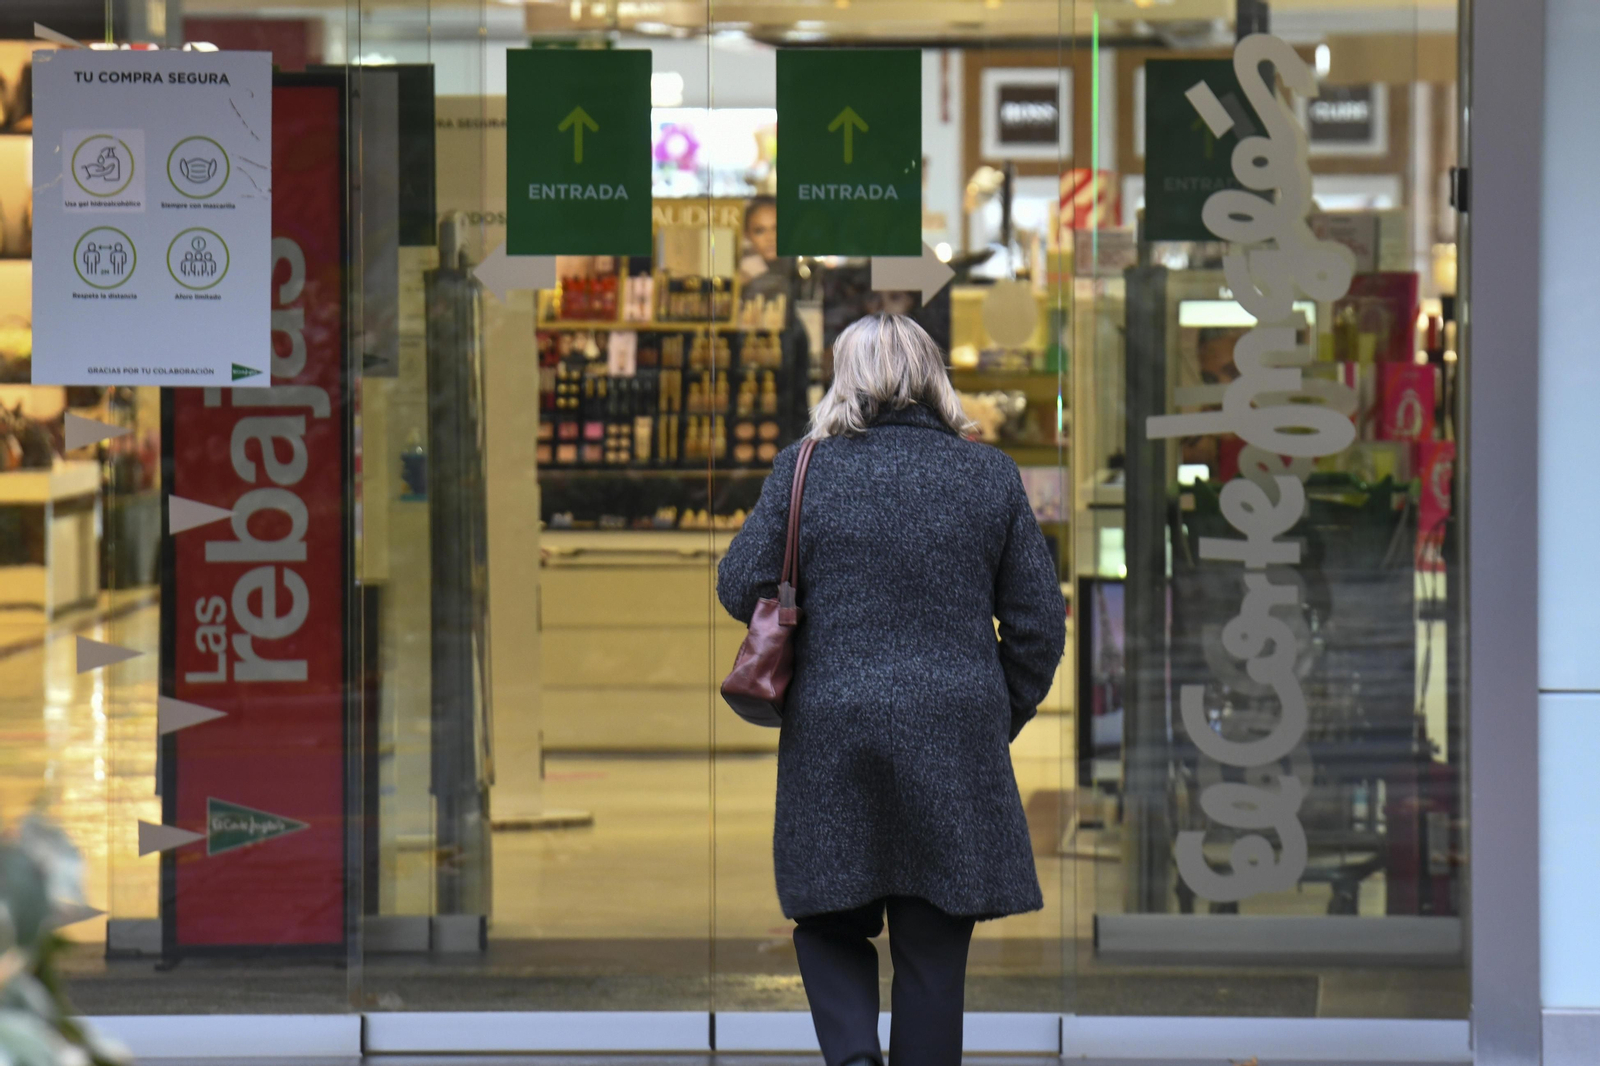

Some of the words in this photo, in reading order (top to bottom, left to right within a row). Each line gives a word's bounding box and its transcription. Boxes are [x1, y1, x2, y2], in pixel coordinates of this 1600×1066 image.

[73, 71, 94, 83] TU
[98, 71, 164, 84] COMPRA
[168, 72, 231, 85] SEGURA
[1163, 176, 1239, 191] ENTRAD
[528, 183, 629, 200] ENTRADA
[798, 183, 898, 200] ENTRADA
[78, 200, 89, 209] gel
[161, 201, 188, 210] Siempre
[202, 202, 236, 210] mascarilla
[1145, 33, 1357, 458] Inglés
[72, 291, 99, 300] Respeta
[100, 291, 107, 299] la
[108, 291, 138, 300] distancia
[174, 292, 193, 300] Aforo
[194, 292, 222, 300] limitado
[87, 366, 121, 375] GRACIAS
[123, 366, 139, 375] POR
[141, 366, 151, 375] TU
[153, 365, 215, 376] COLABORACIÓN
[1181, 475, 1309, 767] Corte
[185, 595, 227, 683] Las
